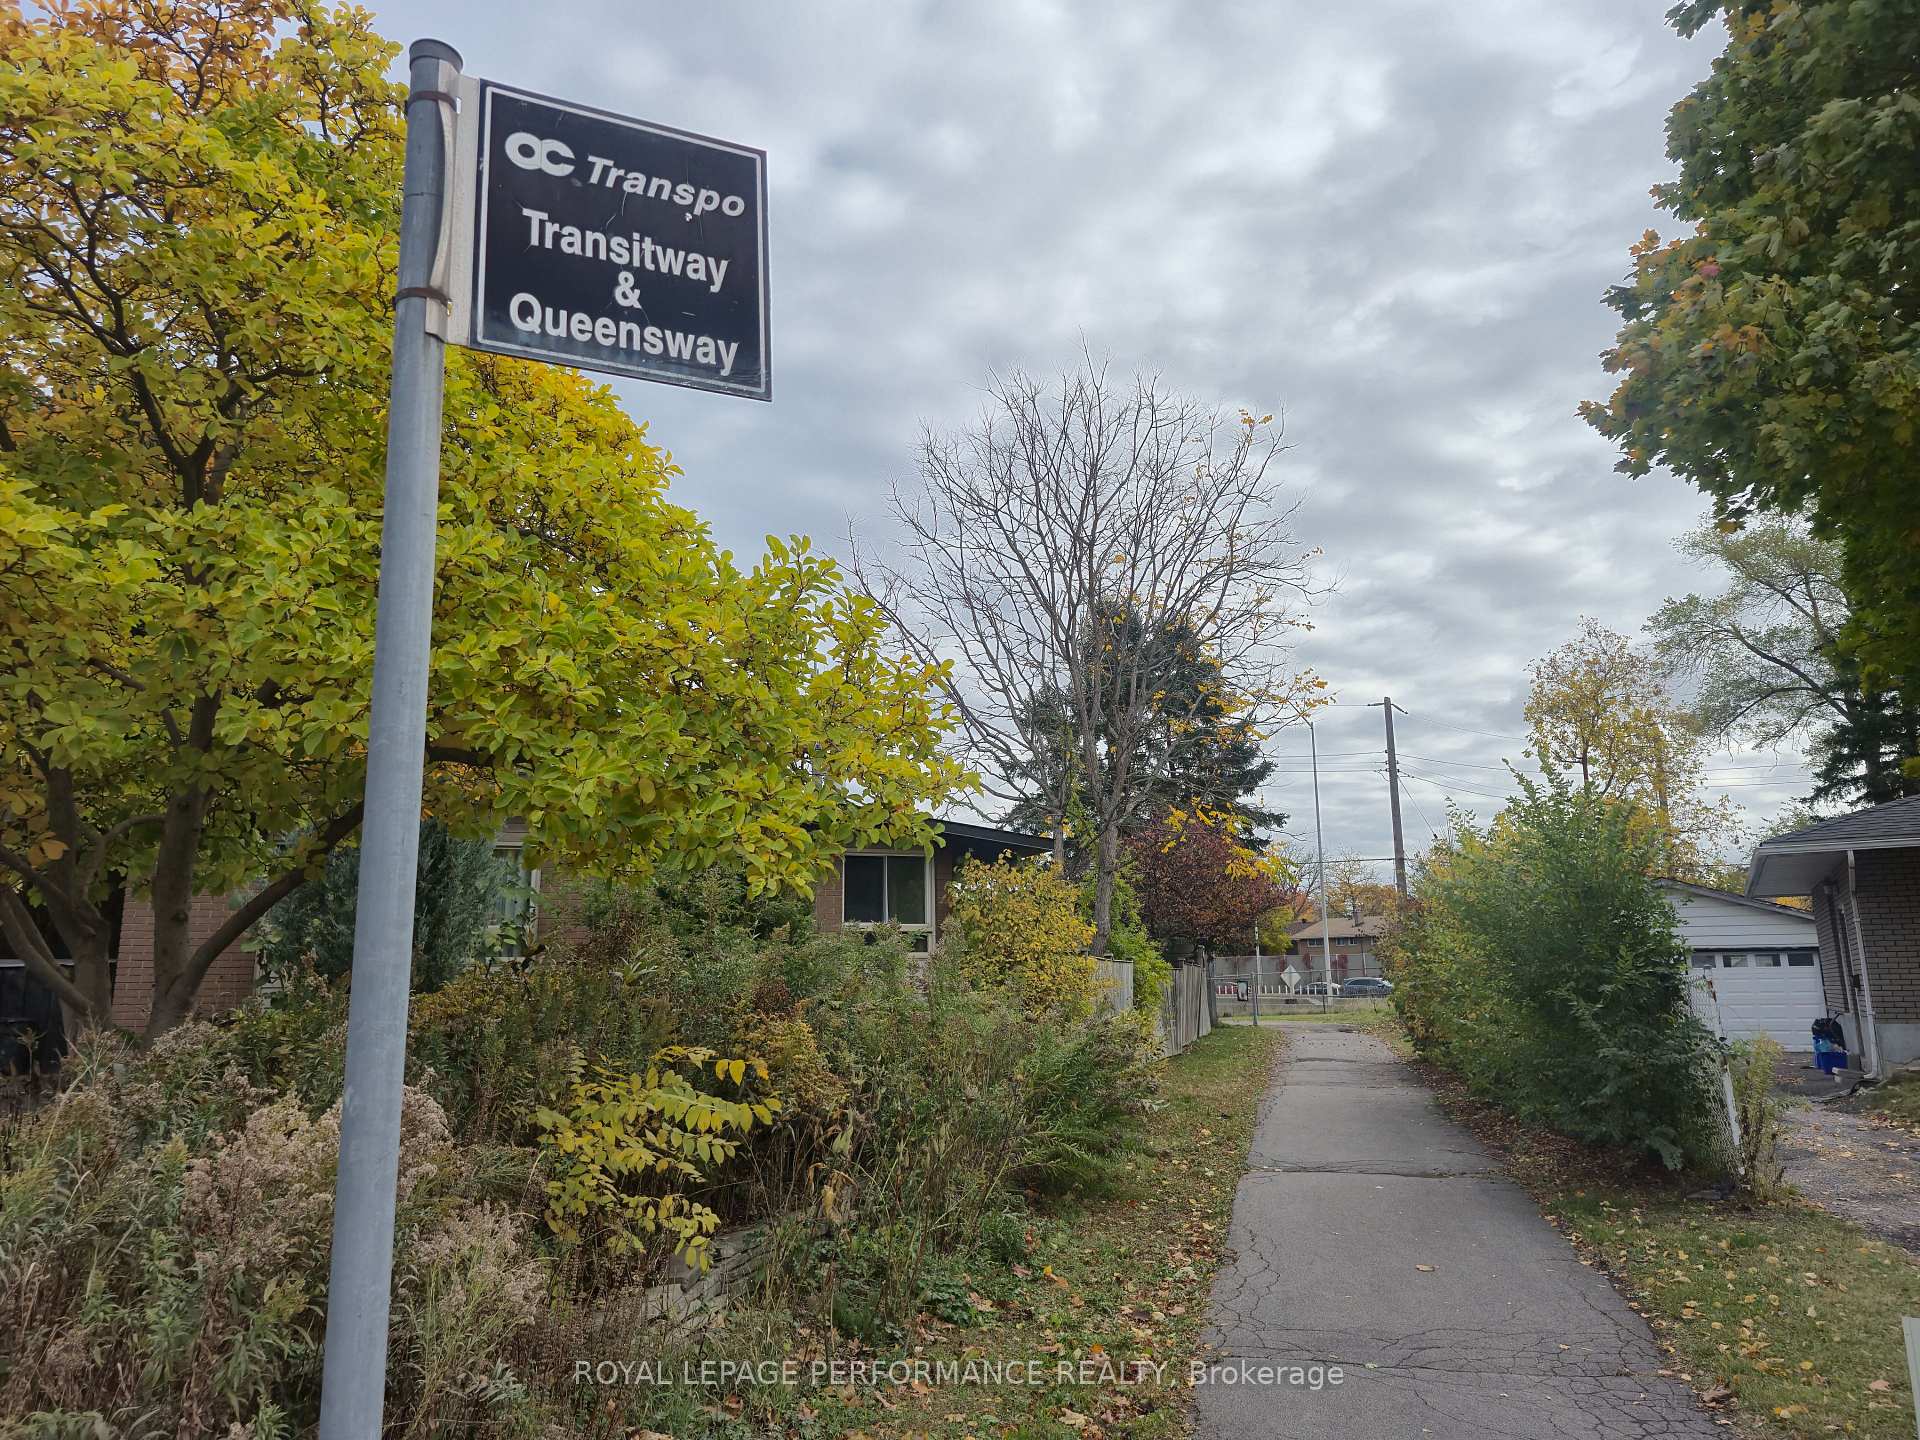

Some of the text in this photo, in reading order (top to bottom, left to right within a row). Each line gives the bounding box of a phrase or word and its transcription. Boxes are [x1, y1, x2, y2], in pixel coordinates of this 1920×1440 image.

[505, 132, 745, 216] OC Transpo
[521, 208, 730, 293] Transitway
[614, 271, 641, 309] &
[509, 292, 739, 377] Queensway
